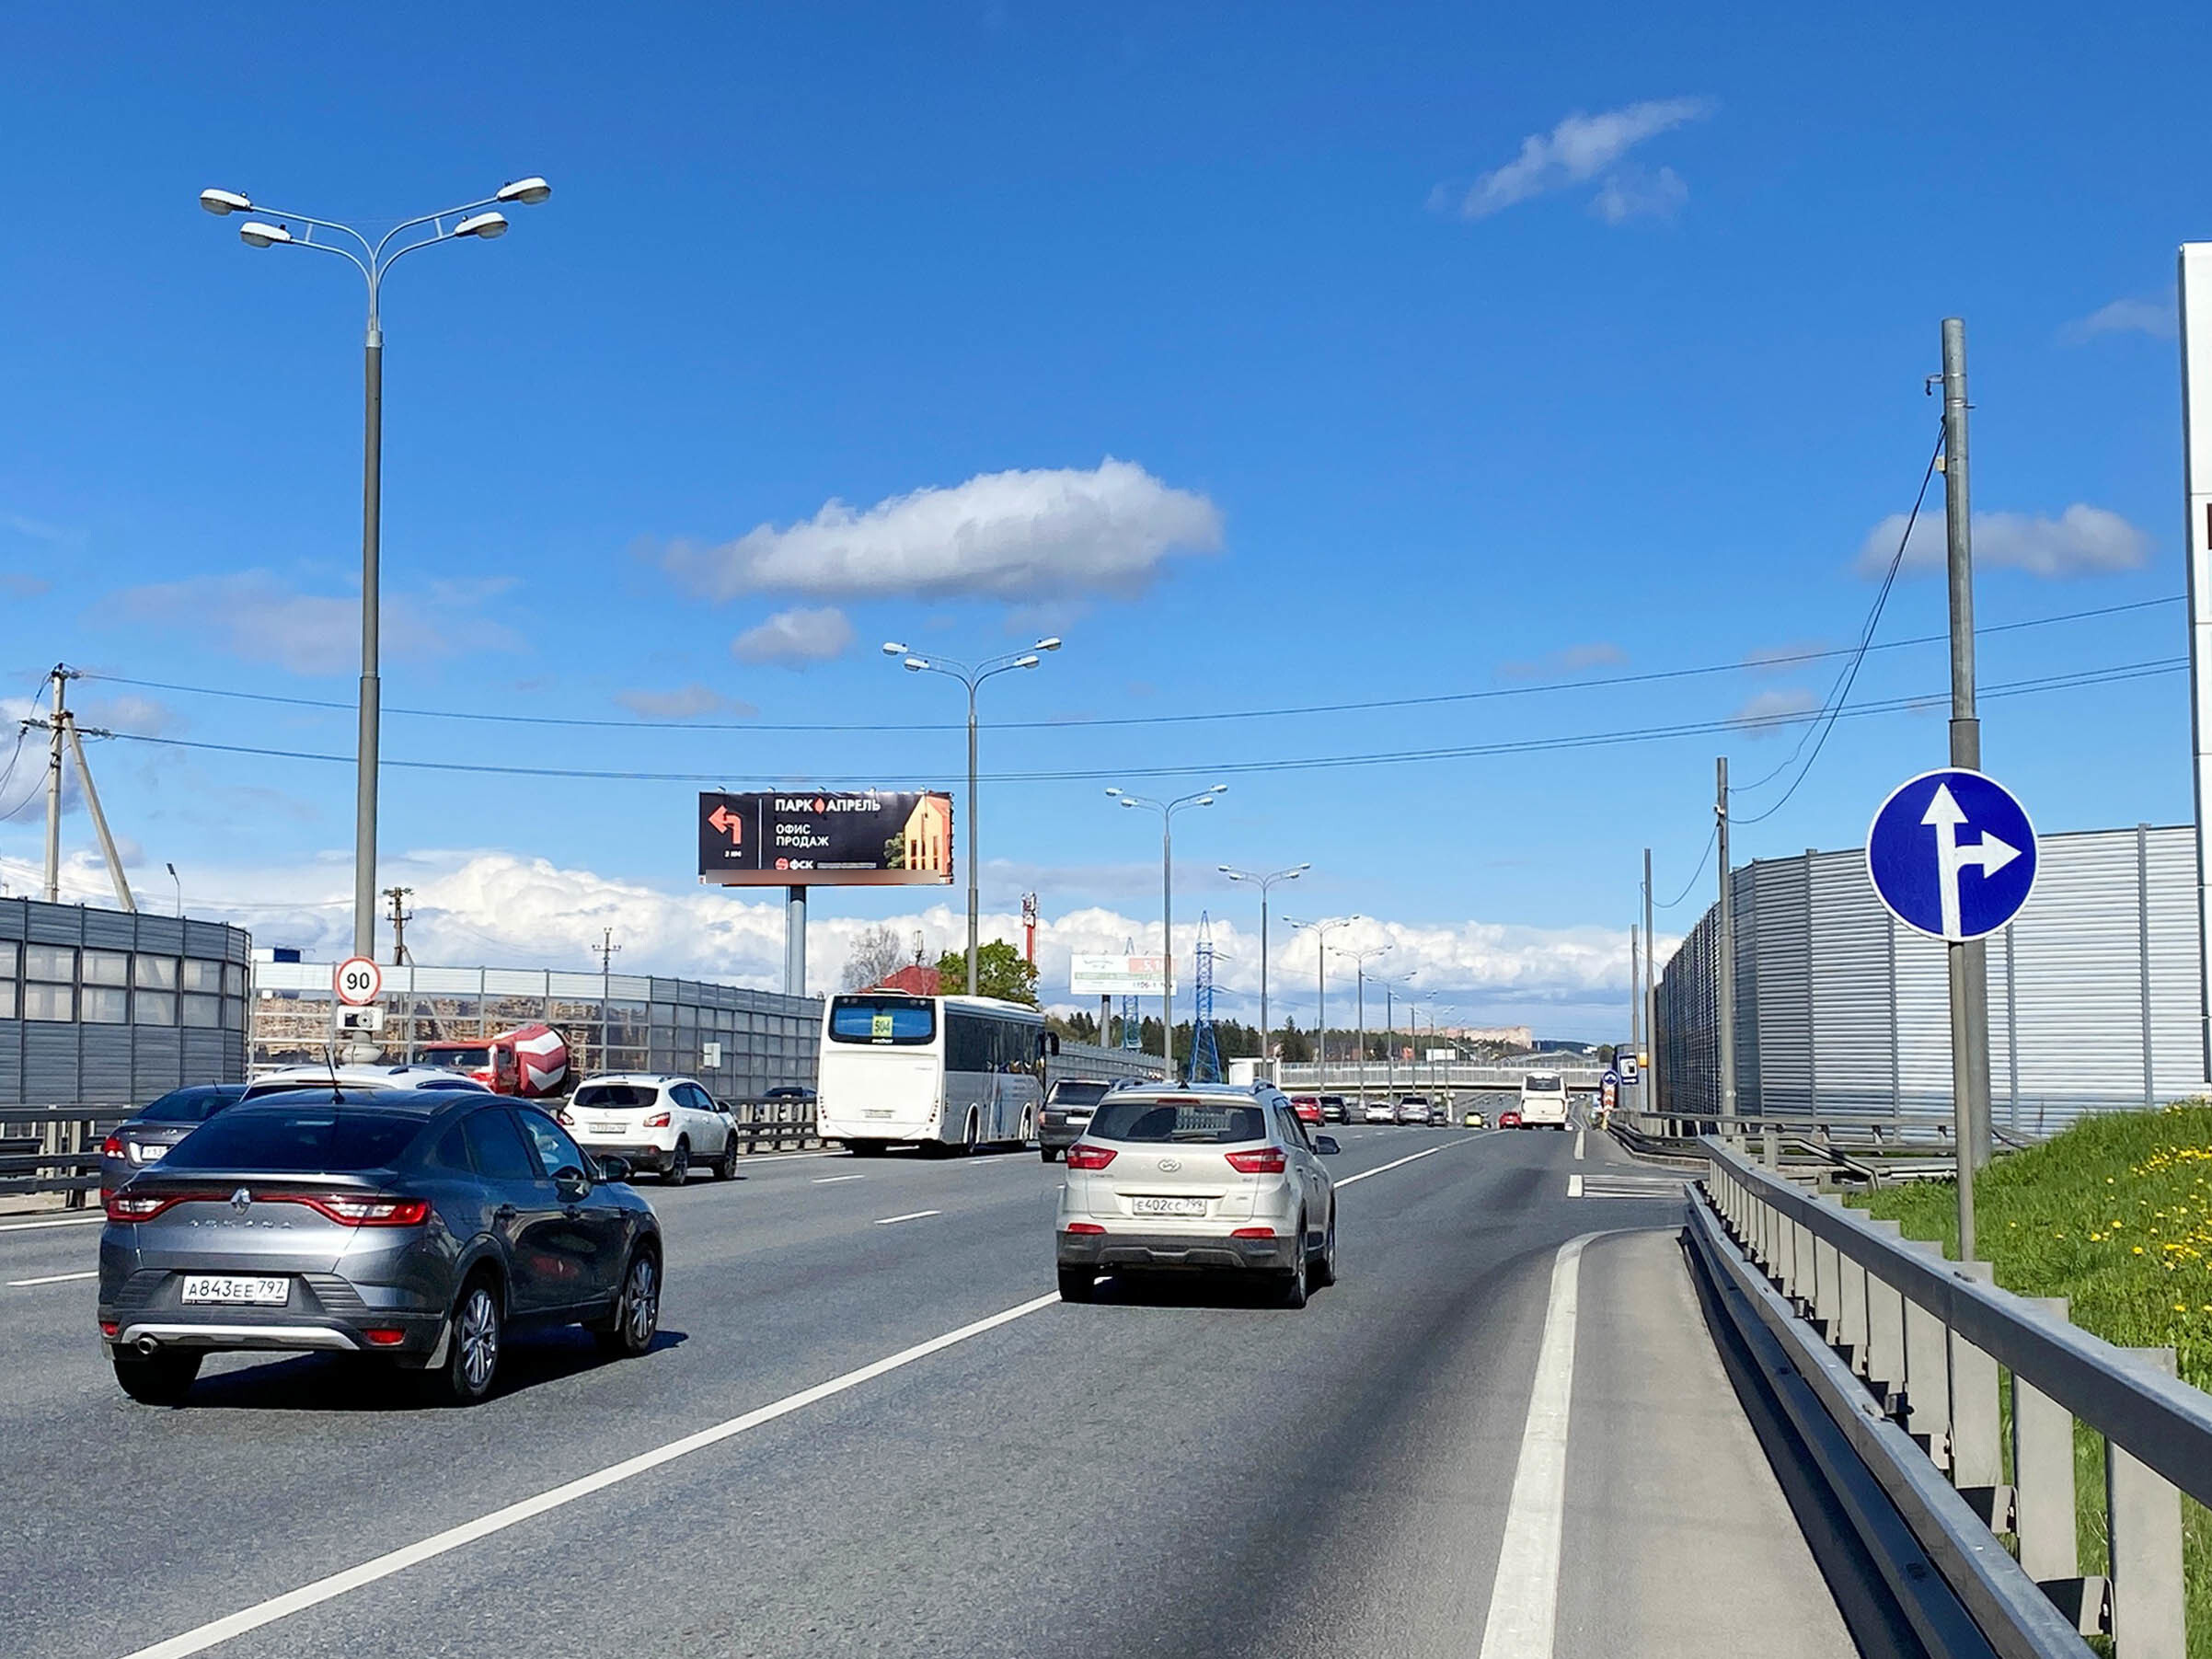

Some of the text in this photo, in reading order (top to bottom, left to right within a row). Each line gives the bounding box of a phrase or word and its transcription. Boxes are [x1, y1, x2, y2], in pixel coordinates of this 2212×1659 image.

[775, 799, 881, 812] ПАРК АПРЕЛЬ
[776, 824, 811, 835] ОФИС
[776, 836, 830, 848] ПРОДАЖ
[789, 858, 813, 870] ФСК
[347, 973, 370, 990] 90
[189, 1280, 284, 1297] А843ЕЕ 797
